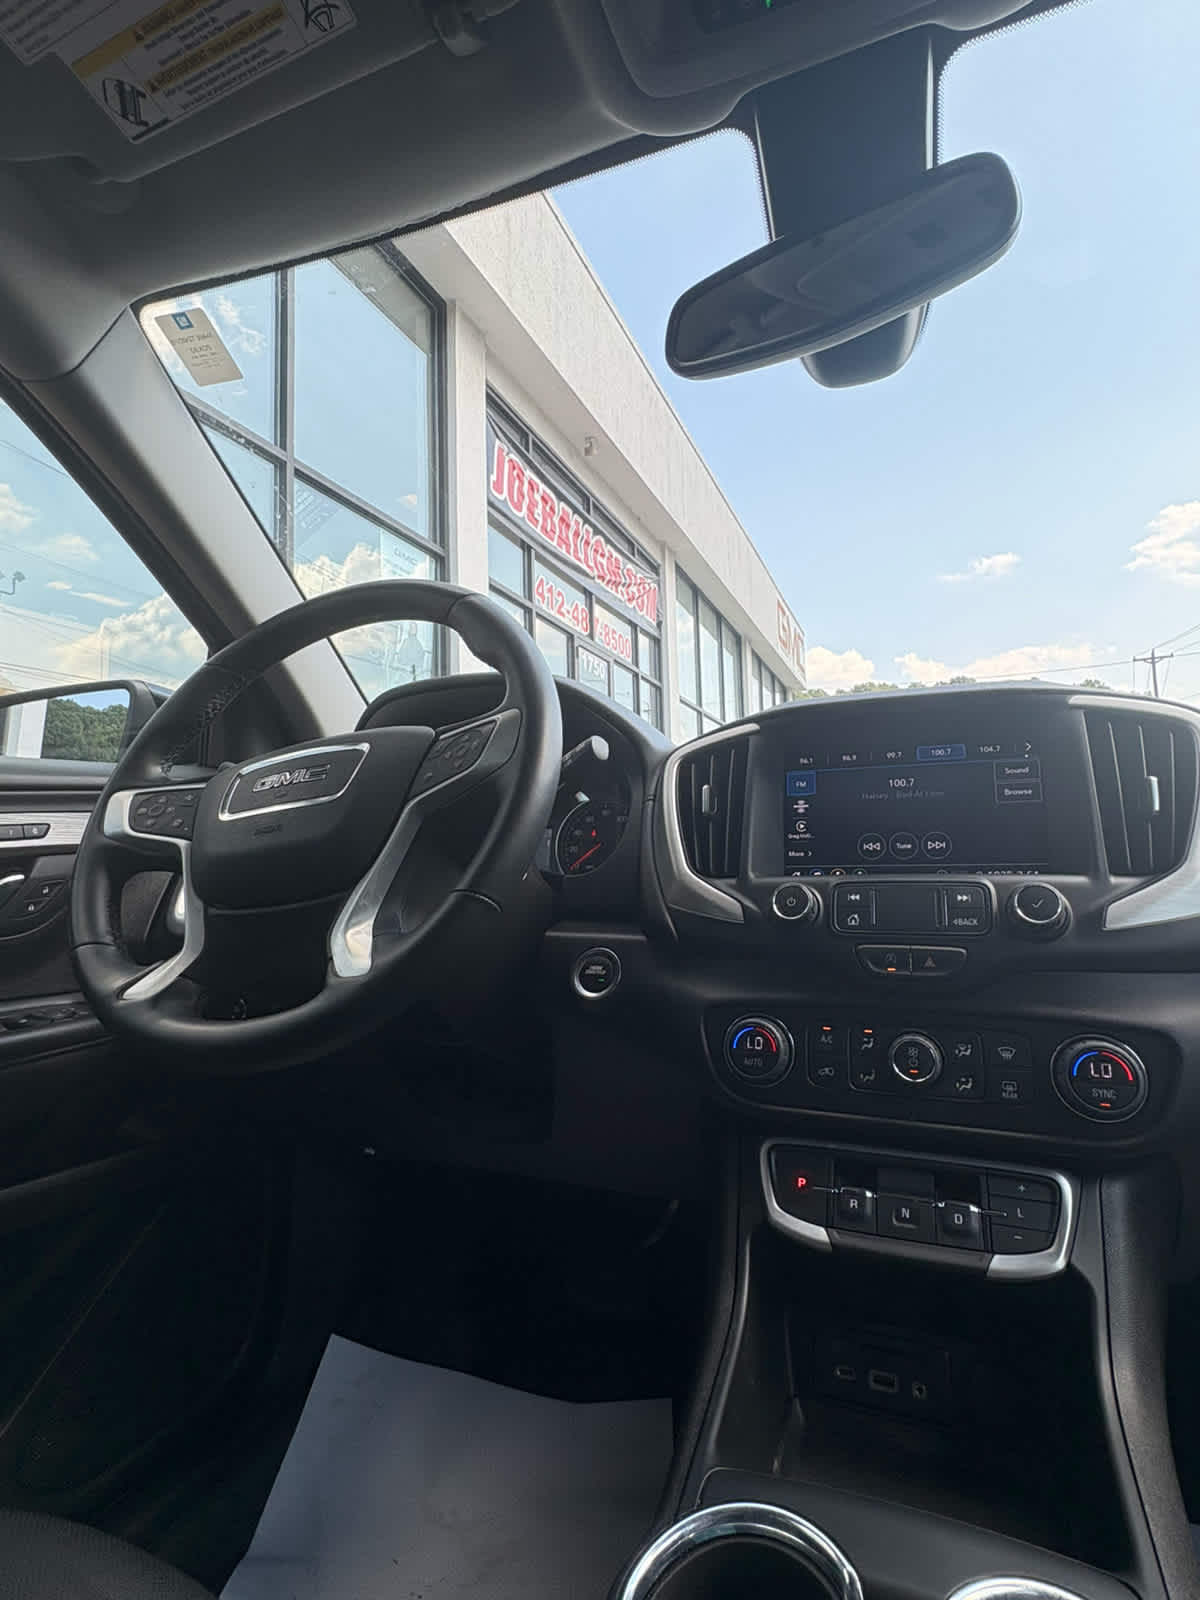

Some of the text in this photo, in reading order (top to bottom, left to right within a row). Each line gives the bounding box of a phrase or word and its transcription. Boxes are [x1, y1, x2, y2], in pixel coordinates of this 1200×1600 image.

[931, 748, 951, 756] 100.7
[979, 745, 1000, 753] 104.7
[252, 765, 330, 792] GMC
[889, 778, 914, 787] 100.7
[1004, 788, 1032, 796] Browse
[958, 917, 978, 926] BACK
[1090, 1062, 1112, 1079] LO
[1091, 1087, 1116, 1099] SYNC
[797, 1176, 807, 1188] P
[849, 1198, 859, 1209] R
[901, 1207, 910, 1219] N
[954, 1213, 963, 1225] D
